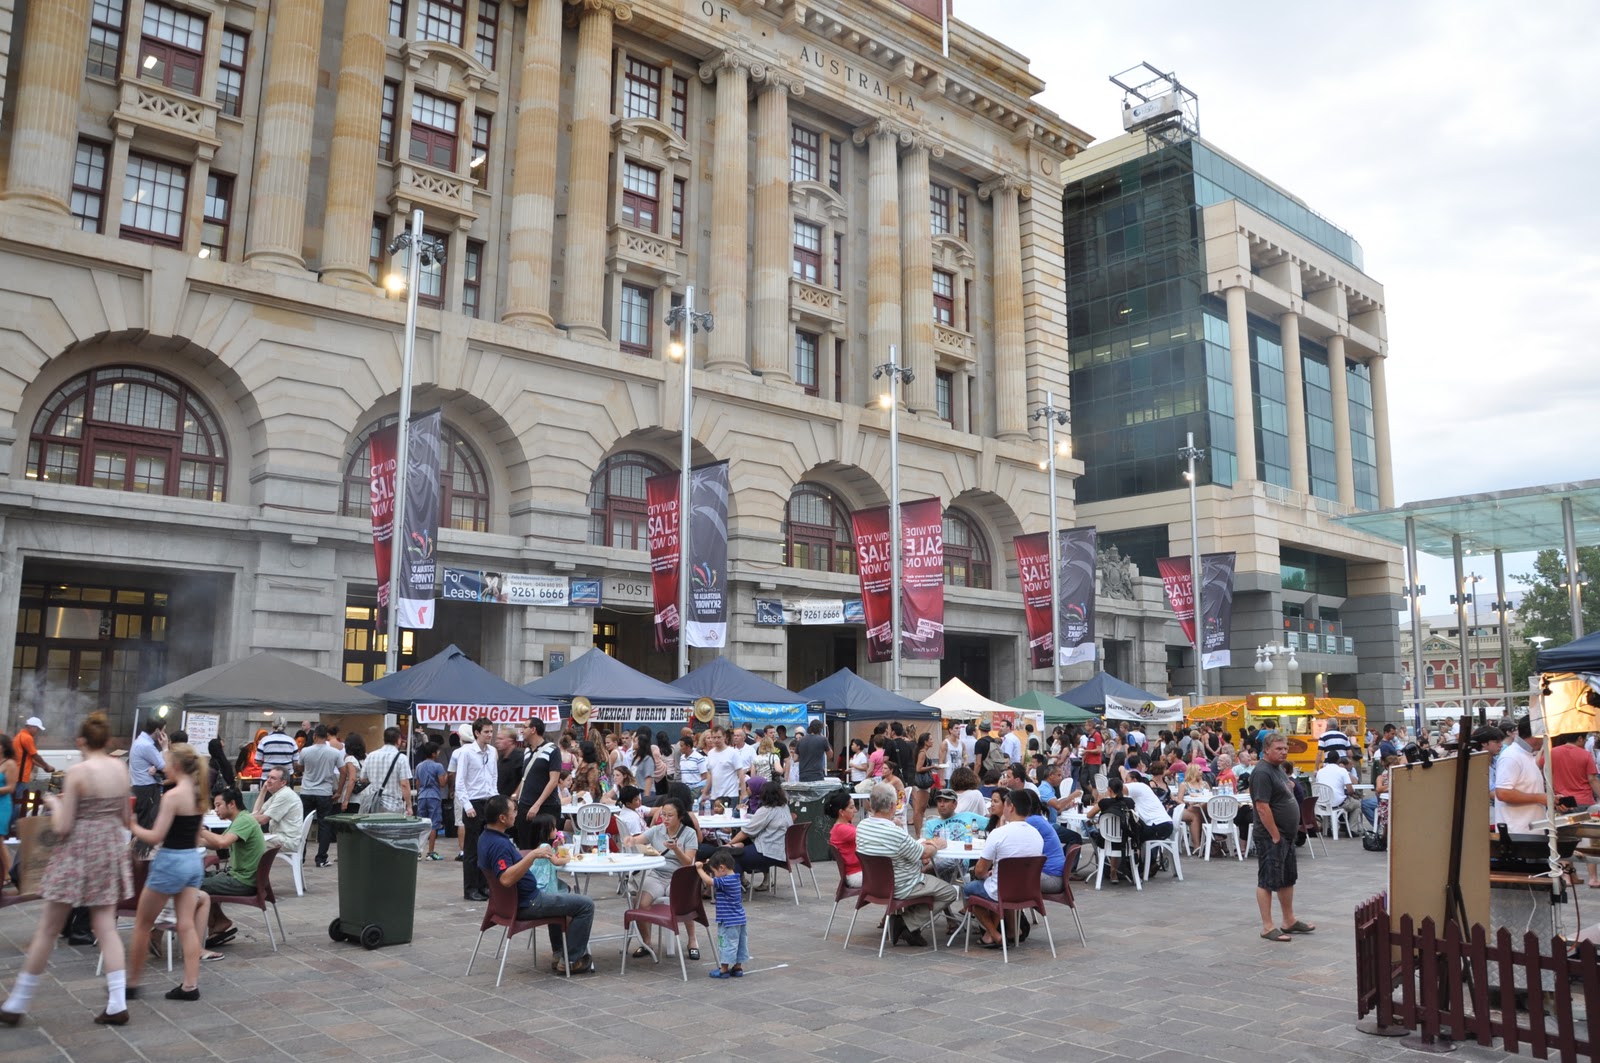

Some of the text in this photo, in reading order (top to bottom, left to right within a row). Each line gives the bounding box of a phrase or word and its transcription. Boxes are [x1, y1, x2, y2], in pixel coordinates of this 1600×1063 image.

[701, 1, 915, 112] OF AUSTRALIA
[384, 458, 396, 472] WID
[647, 504, 661, 516] CITY
[648, 512, 678, 538] SALE
[858, 532, 890, 545] CITY WID
[443, 570, 464, 583] For
[861, 564, 882, 576] NOW
[1022, 563, 1050, 582] SALE
[443, 585, 477, 600] Lease
[511, 586, 564, 599] 9261 6666
[617, 583, 651, 596] POST
[1024, 582, 1042, 593] NOW
[1165, 582, 1192, 598] SALE
[757, 600, 771, 610] For
[757, 613, 783, 623] Lease
[804, 610, 840, 619] 9261 6666
[597, 707, 685, 721] MEXICAN BURRITO BAR
[738, 703, 752, 712] The
[754, 704, 779, 715] Hungry
